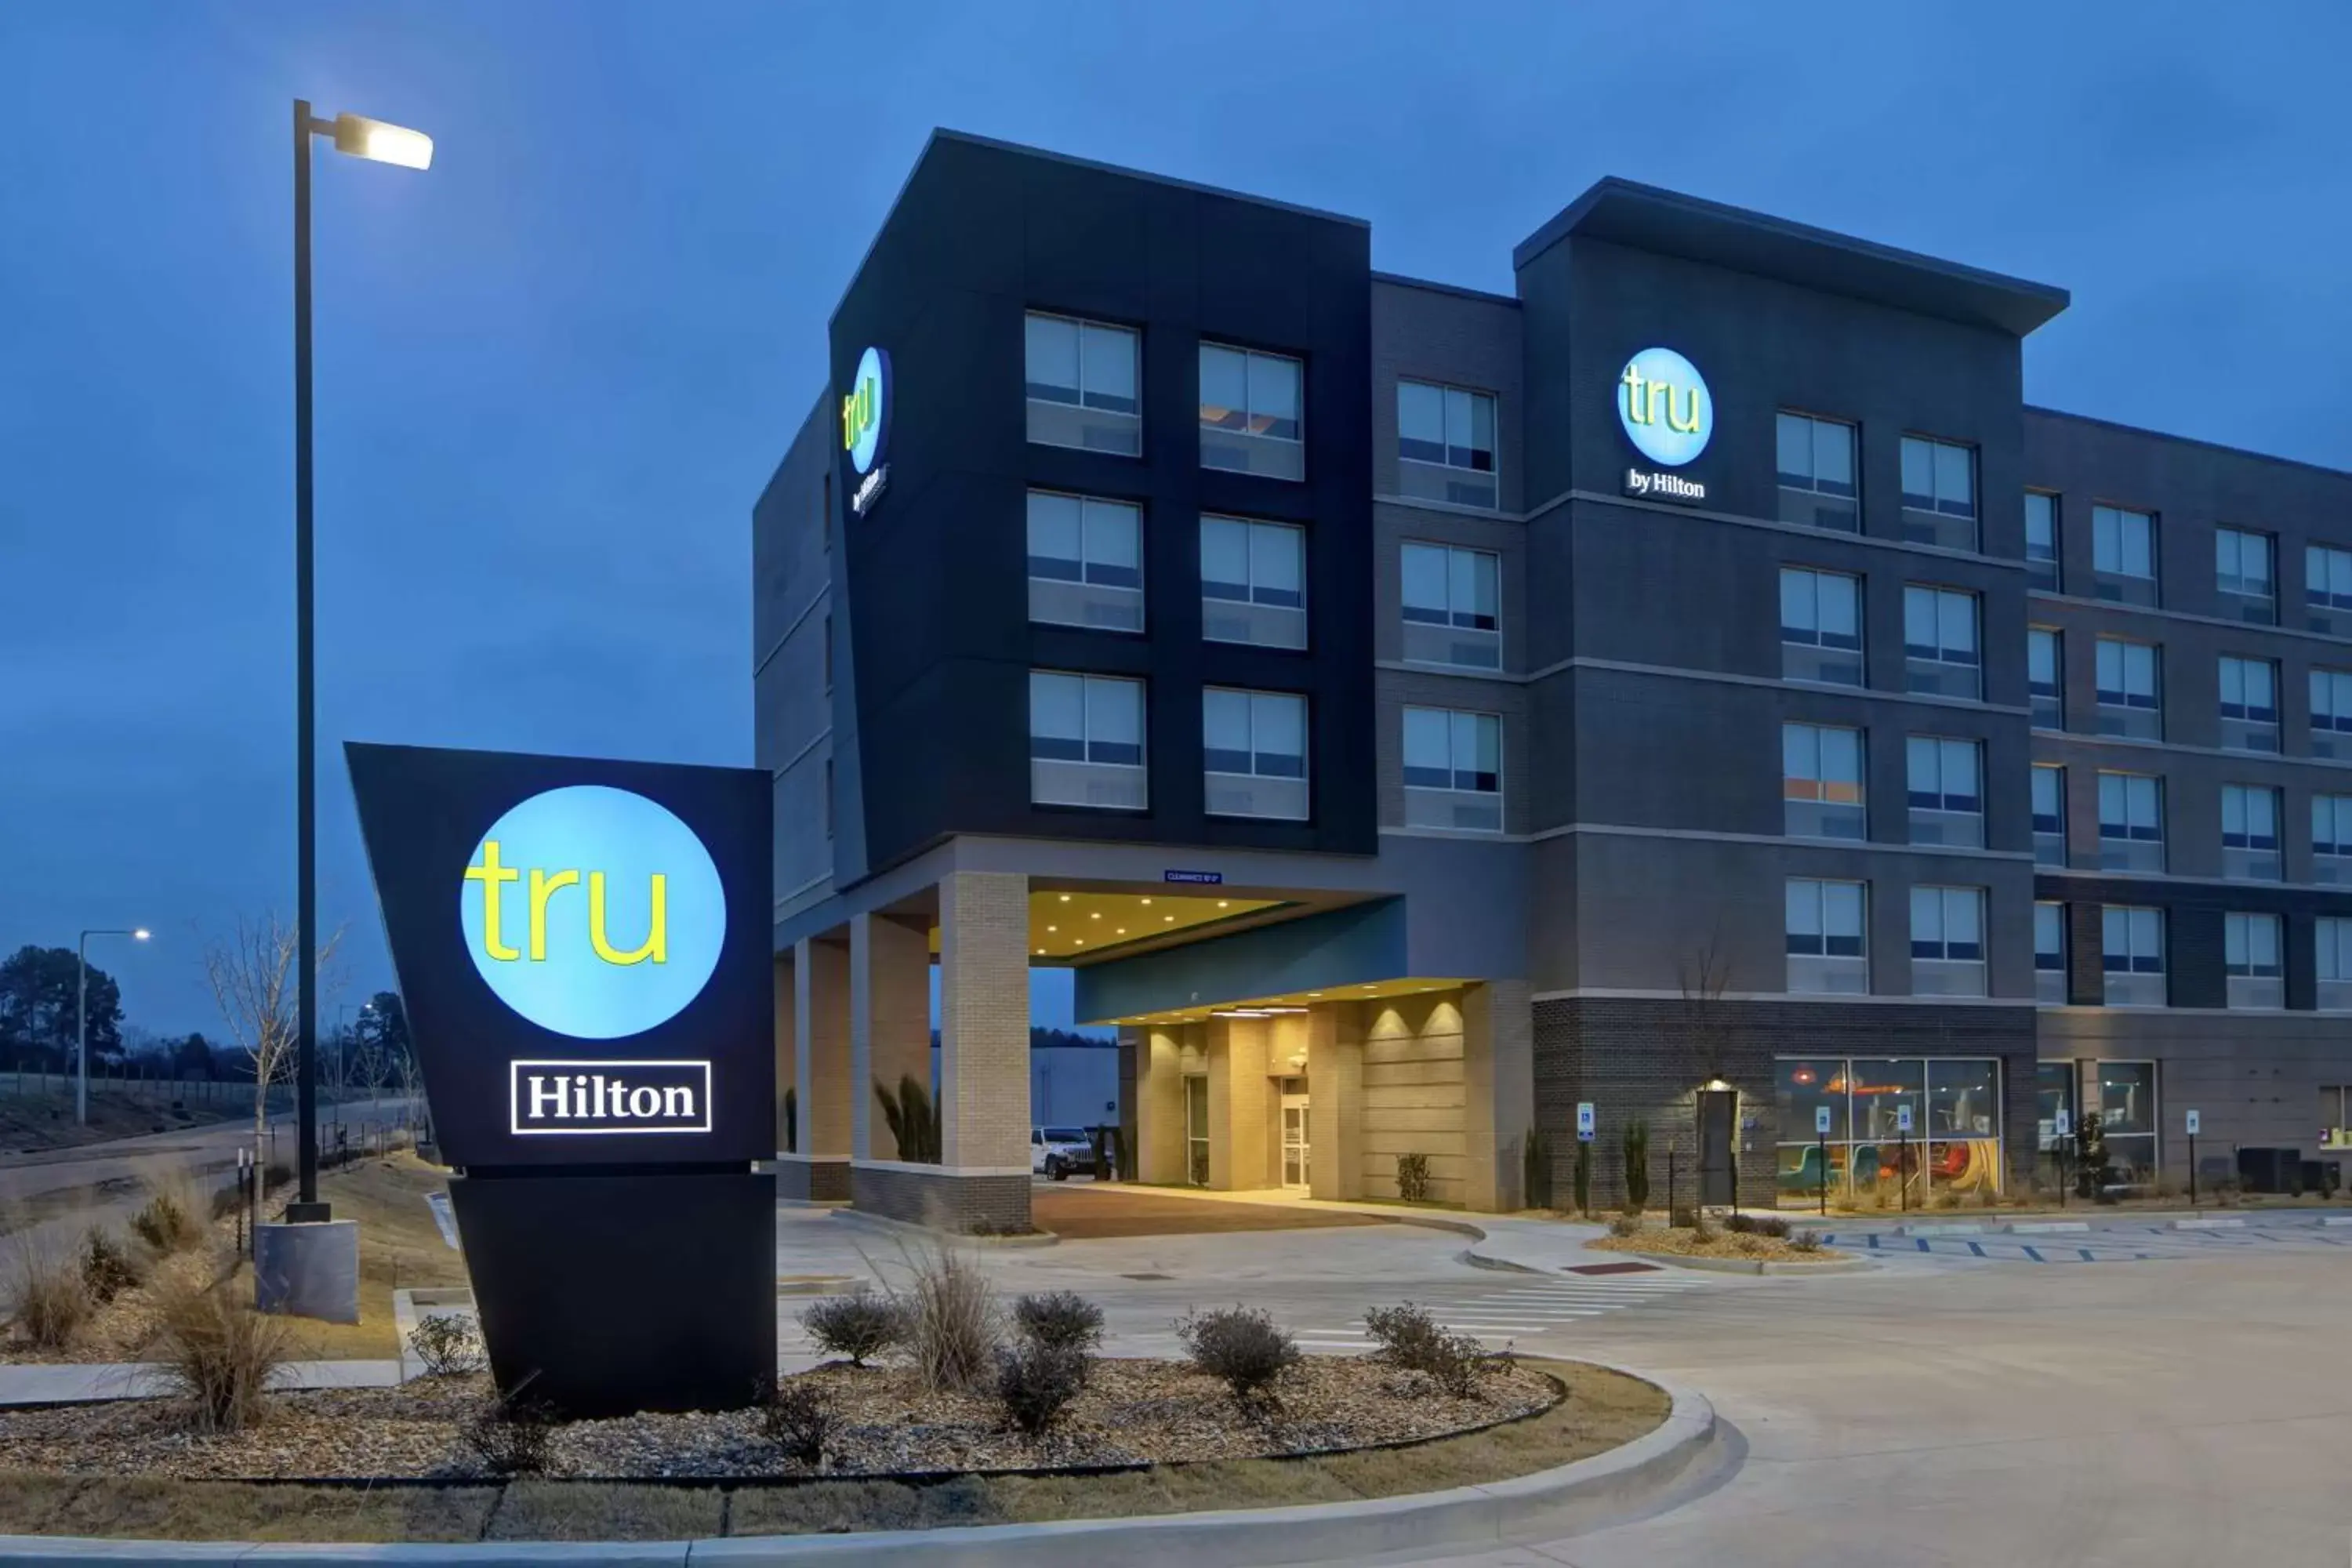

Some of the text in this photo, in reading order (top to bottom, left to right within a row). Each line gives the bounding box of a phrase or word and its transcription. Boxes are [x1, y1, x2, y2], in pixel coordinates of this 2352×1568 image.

[1624, 364, 1700, 434] tru
[1629, 468, 1705, 498] by Hilton
[463, 840, 668, 966] tru
[528, 1075, 695, 1119] Hilton
